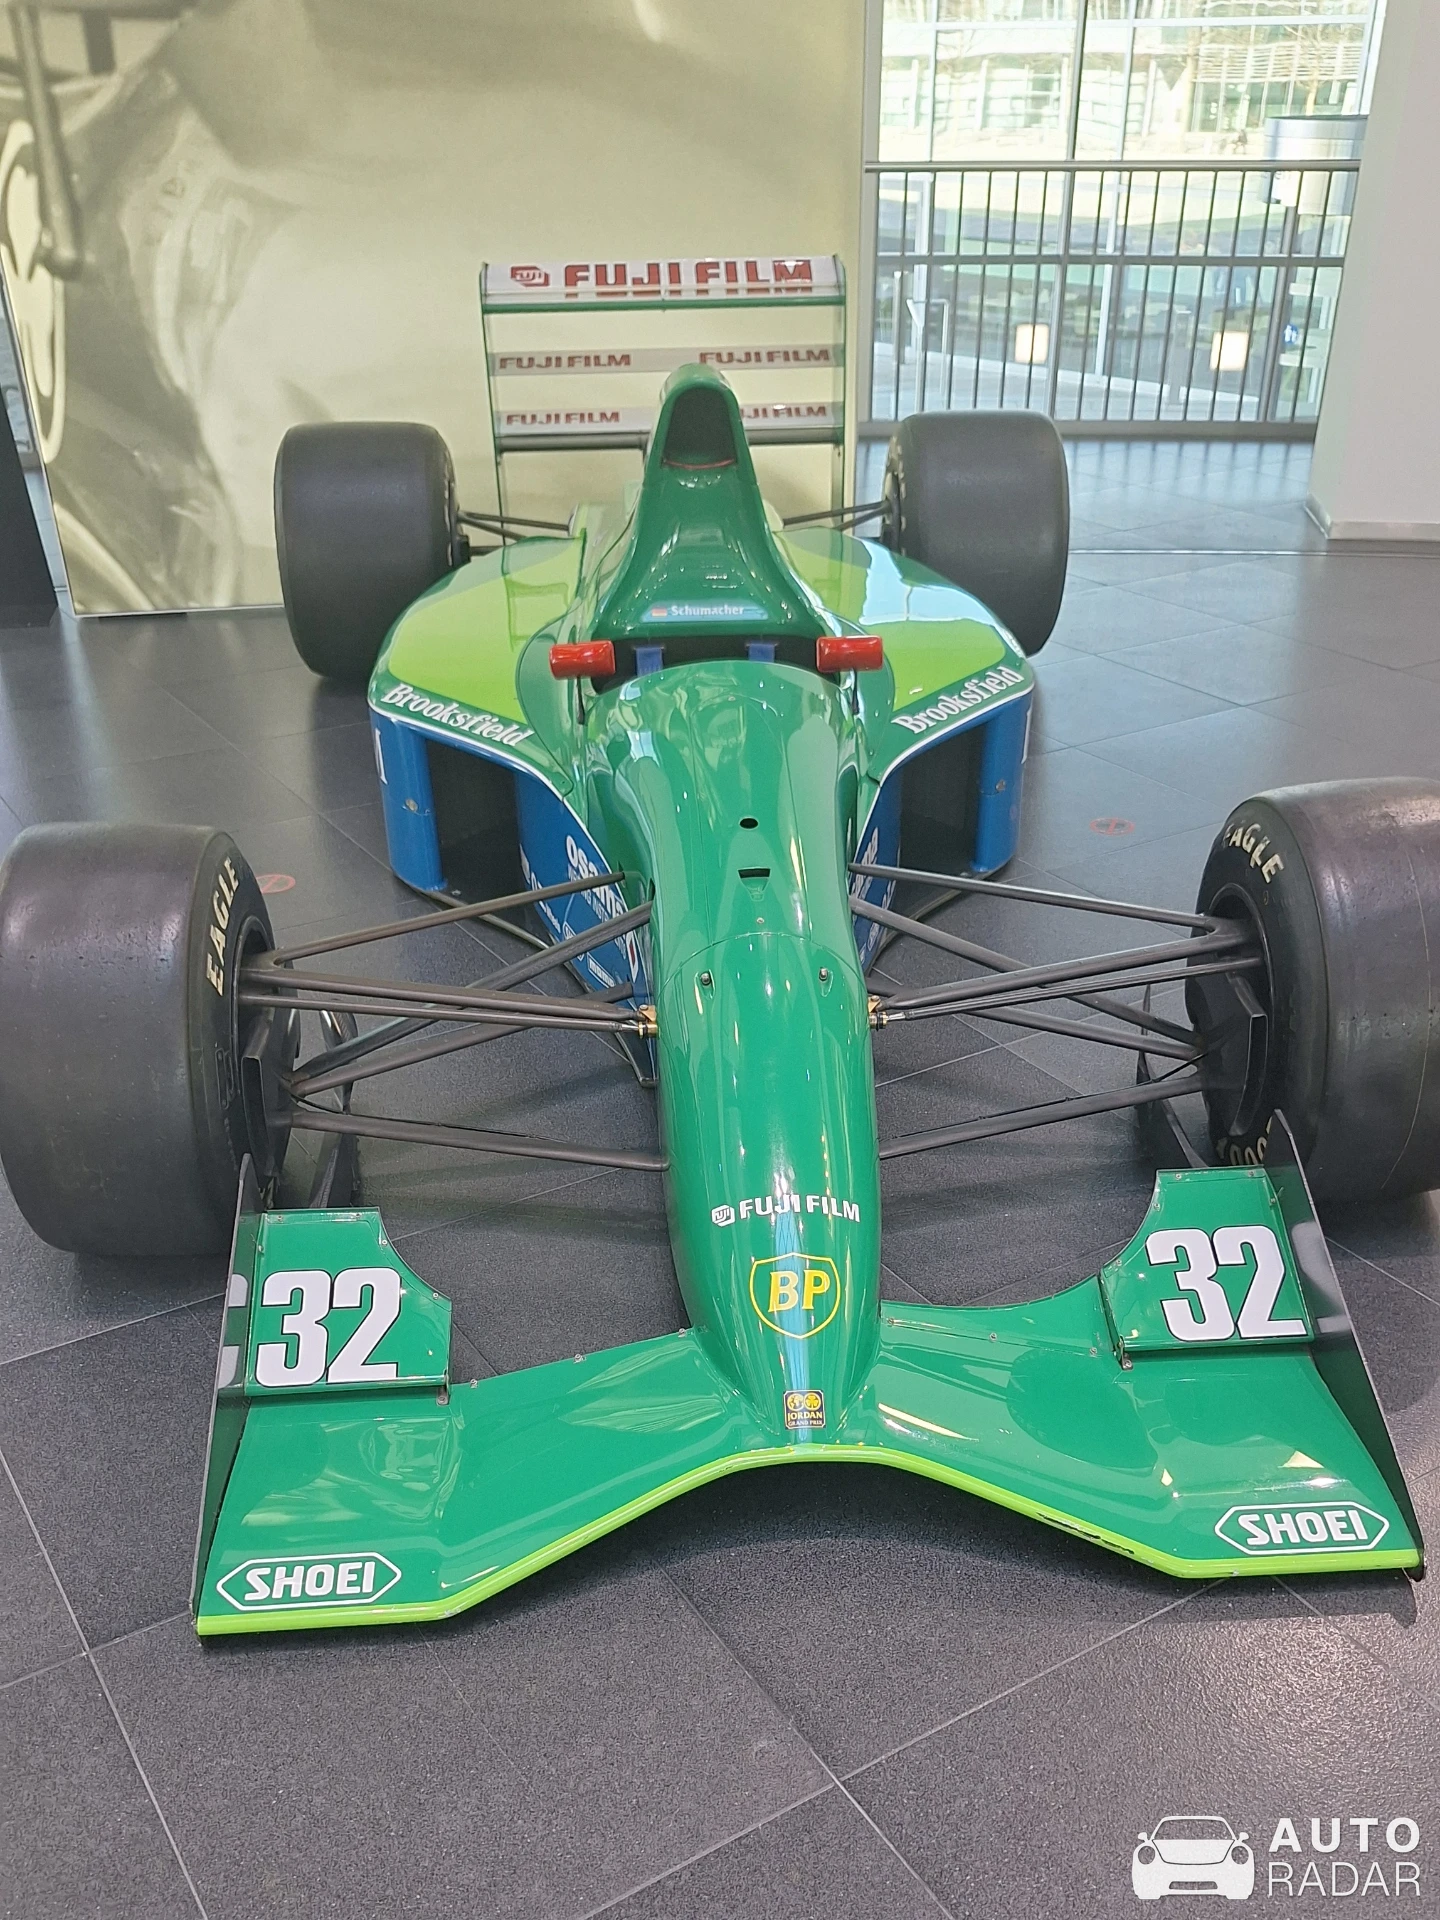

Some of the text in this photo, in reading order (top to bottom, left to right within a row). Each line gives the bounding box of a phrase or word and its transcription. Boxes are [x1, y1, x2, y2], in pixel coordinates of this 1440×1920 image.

[563, 262, 682, 298] FUJI
[695, 260, 813, 297] FILM
[499, 354, 631, 370] FUJI FILM
[698, 349, 830, 365] FUJI FILM
[506, 411, 620, 426] FUJI FILM
[670, 604, 745, 617] Schumacher
[380, 683, 535, 746] Brooksfield
[891, 665, 1025, 735] Brooksfield
[206, 857, 239, 996] EAGLE
[739, 1194, 801, 1219] FUJI
[805, 1194, 861, 1223] FILM
[768, 1269, 831, 1313] BP
[1145, 1225, 1307, 1341] 32
[255, 1267, 402, 1388] 32
[787, 1412, 823, 1421] JORDAN
[1237, 1507, 1368, 1546] SHOEI
[244, 1560, 376, 1600] SHOEI
